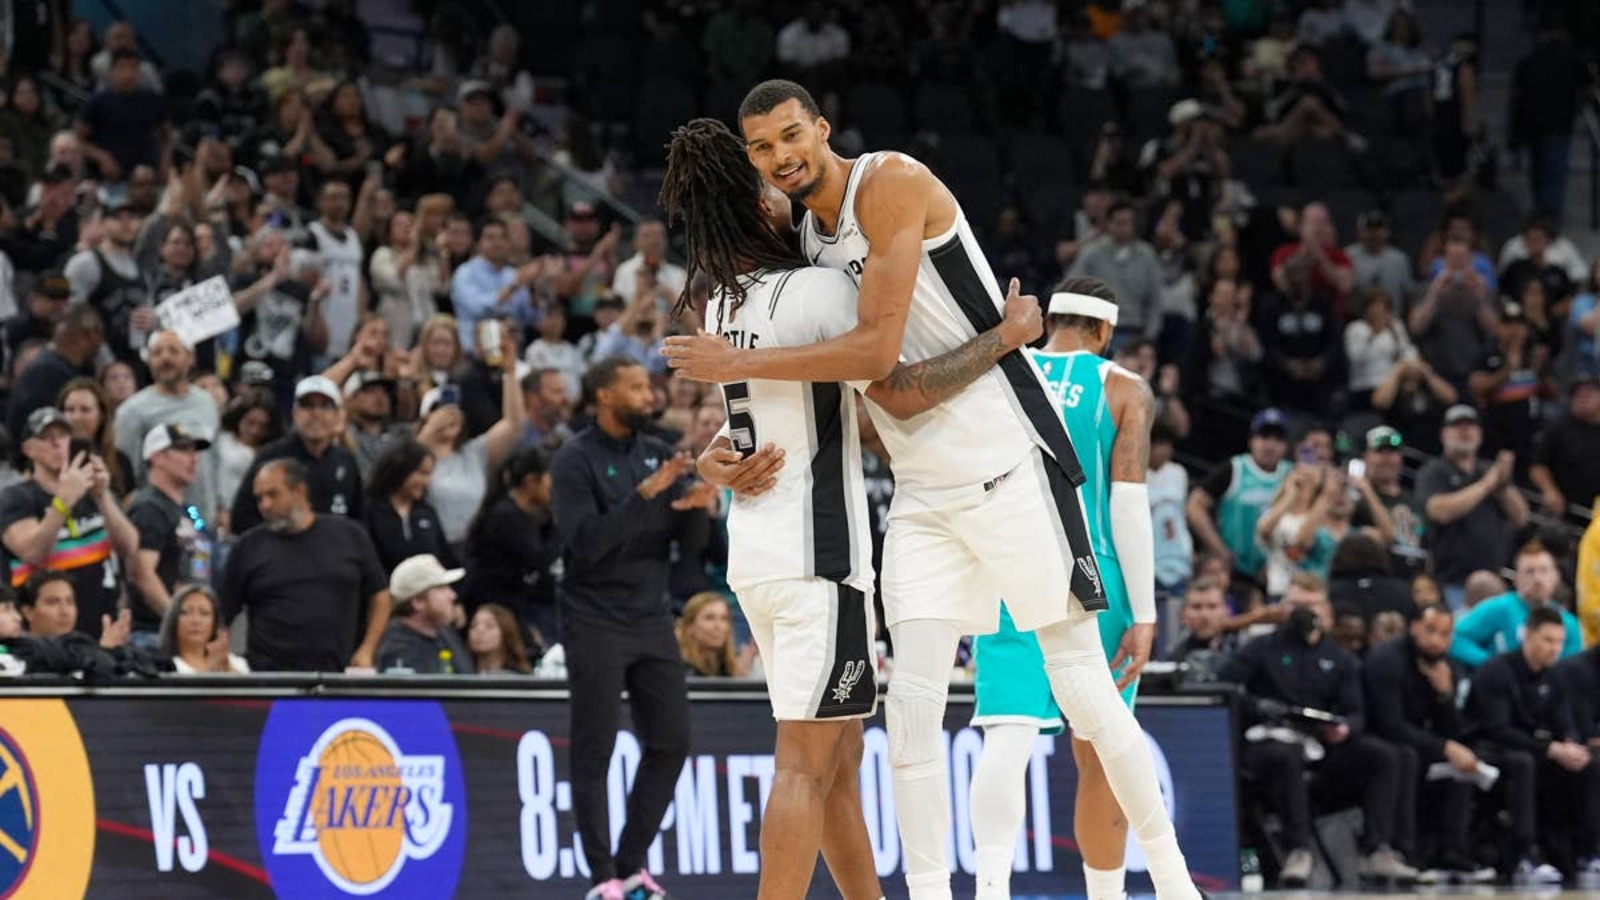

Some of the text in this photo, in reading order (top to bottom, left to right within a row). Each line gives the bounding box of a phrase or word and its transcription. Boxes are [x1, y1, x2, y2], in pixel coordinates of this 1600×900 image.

[723, 382, 757, 460] 5
[291, 766, 437, 848] LAKERS
[333, 763, 436, 779] LOS ANGELES
[144, 762, 209, 872] VS
